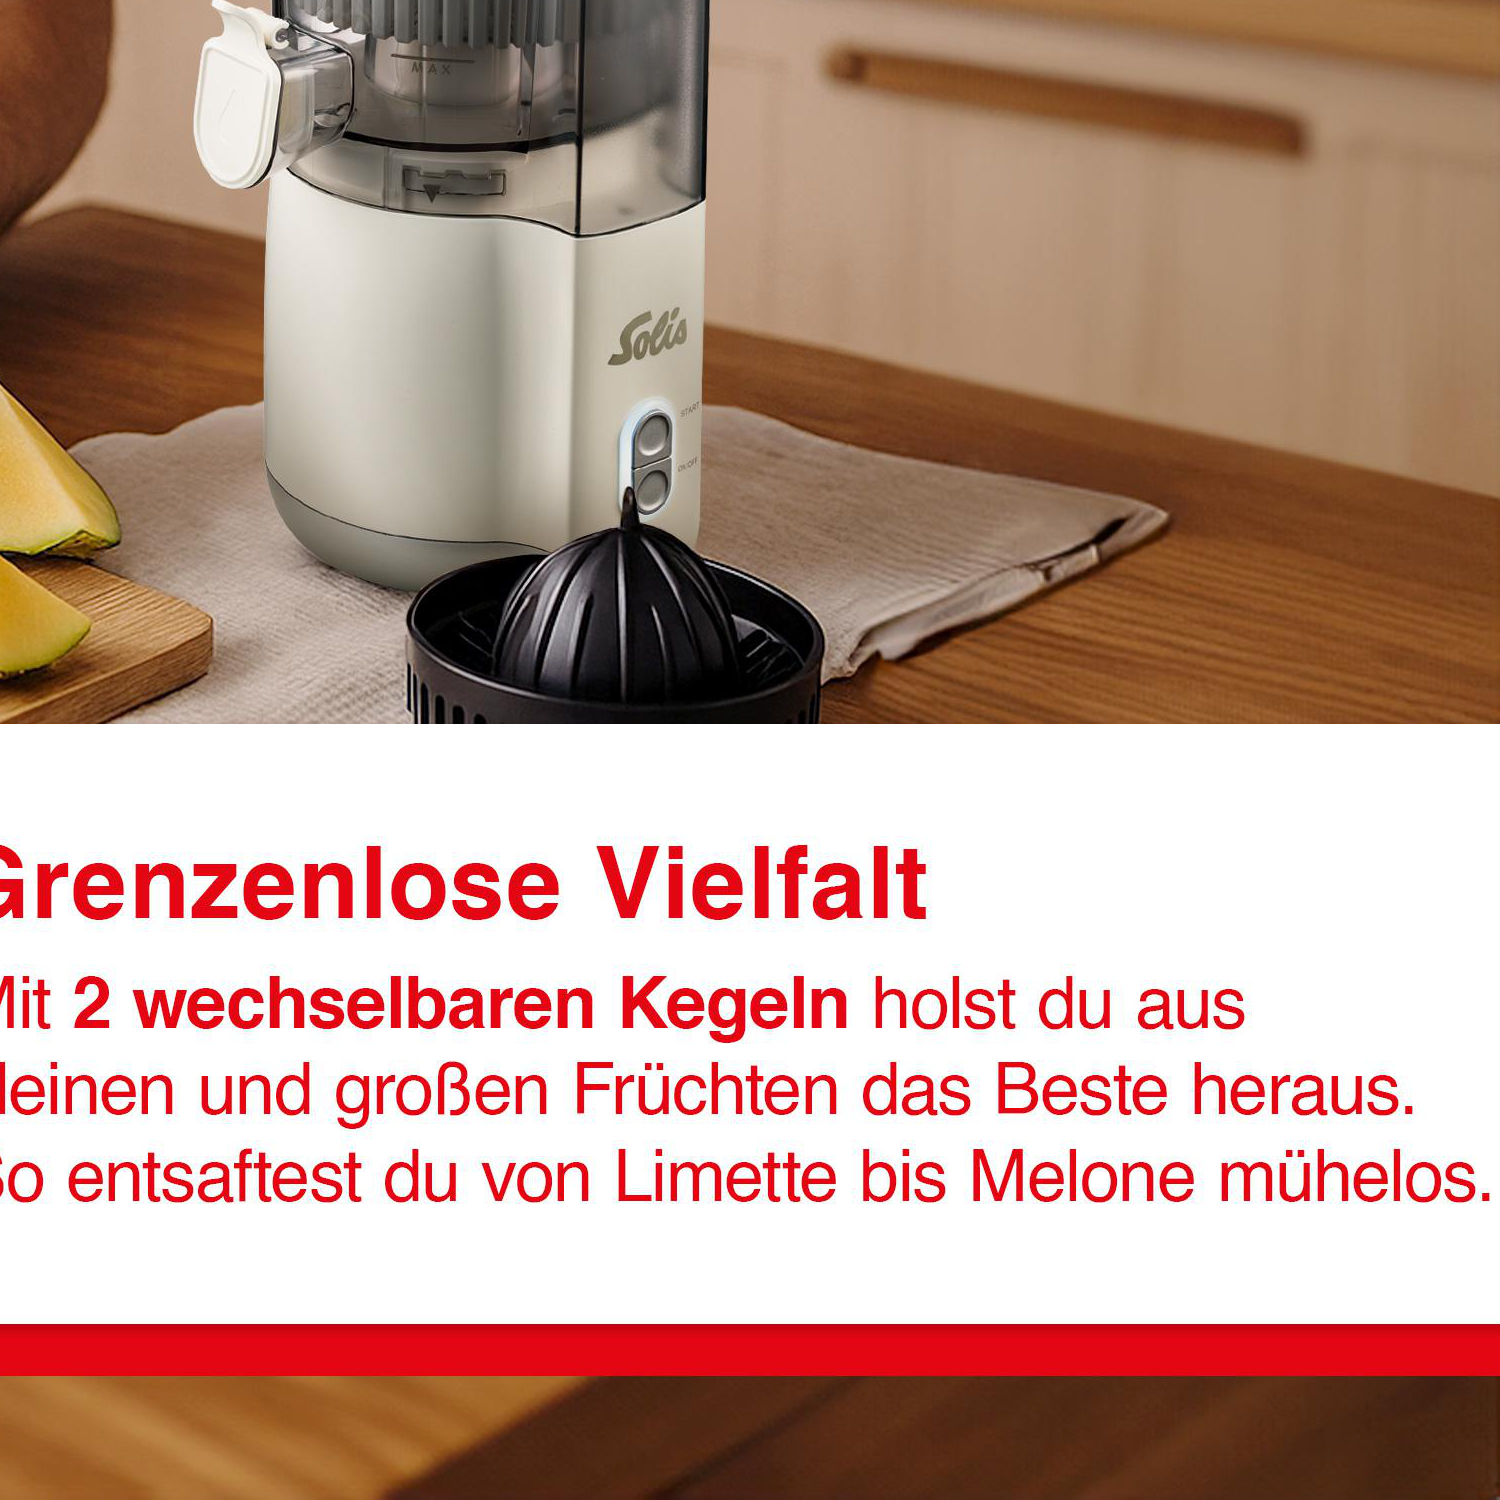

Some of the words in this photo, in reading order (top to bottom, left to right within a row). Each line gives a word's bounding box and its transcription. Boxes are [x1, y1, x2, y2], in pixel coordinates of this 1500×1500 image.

[411, 61, 452, 75] MAX
[607, 307, 688, 366] Solis
[680, 401, 700, 417] START
